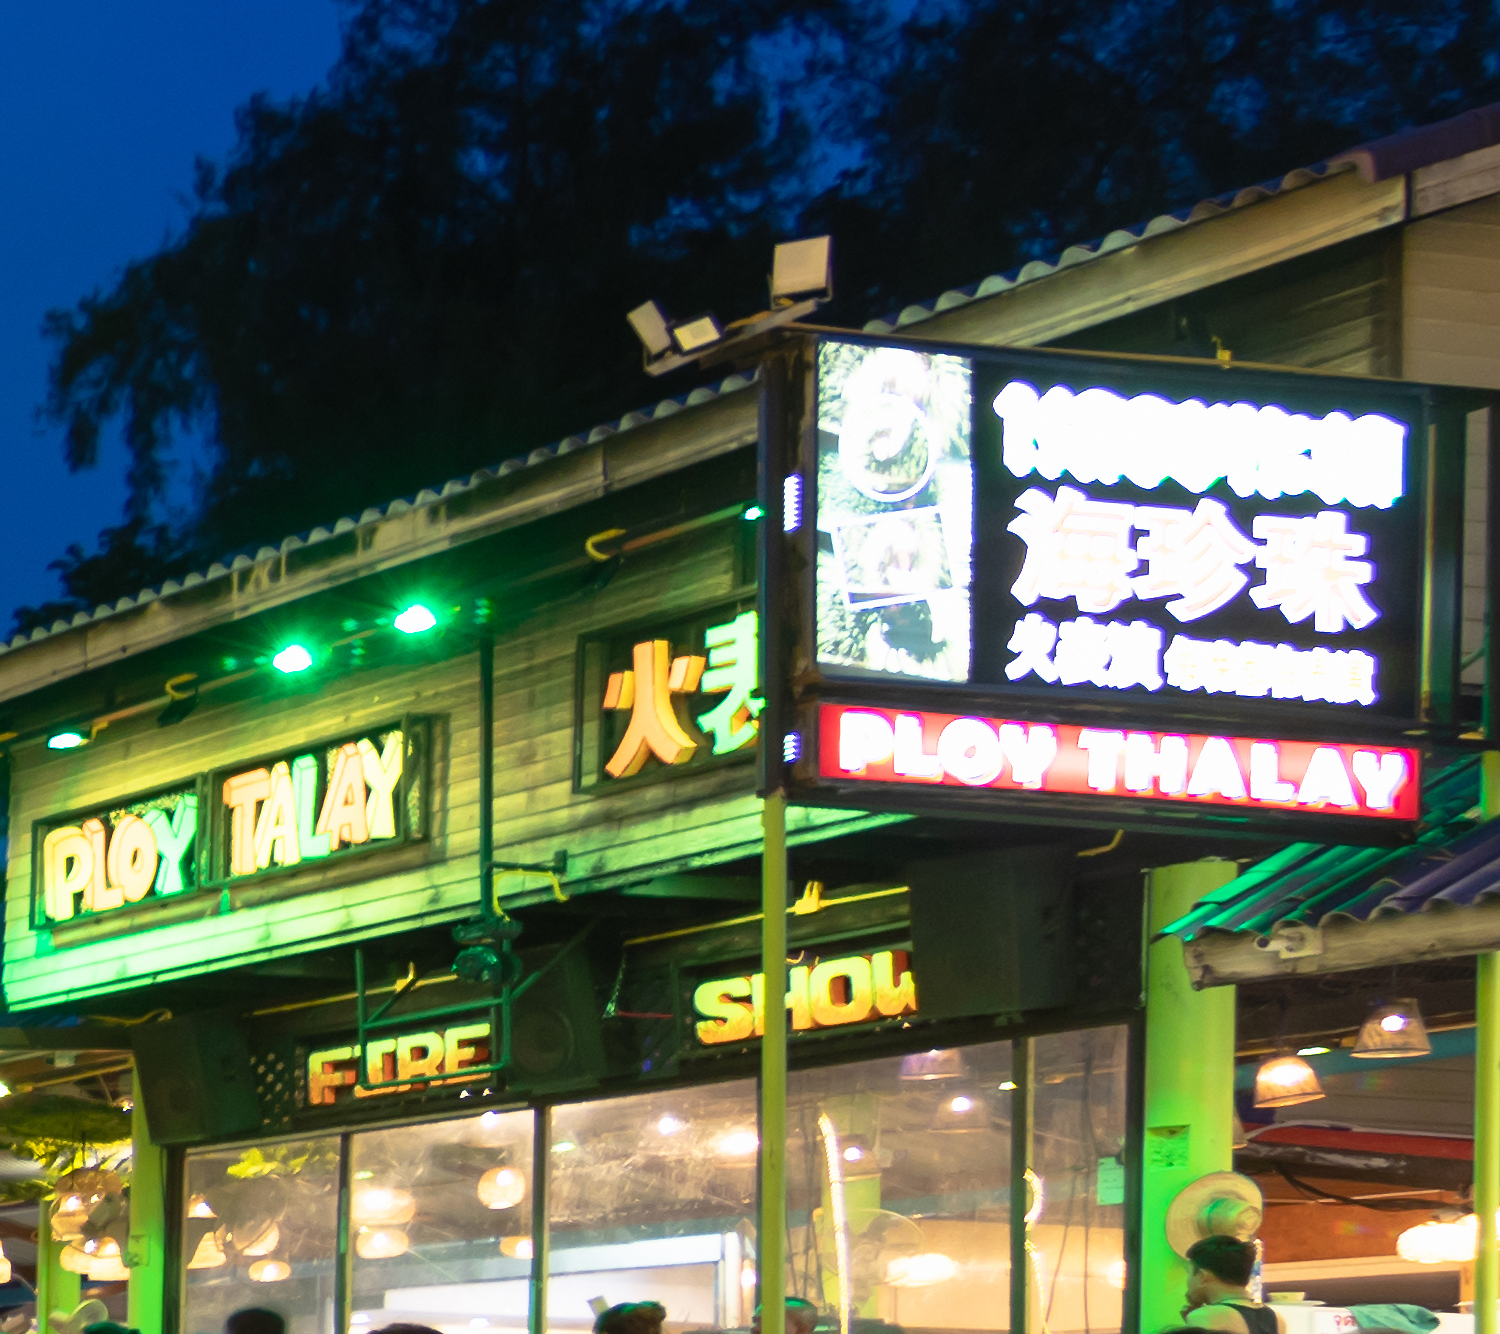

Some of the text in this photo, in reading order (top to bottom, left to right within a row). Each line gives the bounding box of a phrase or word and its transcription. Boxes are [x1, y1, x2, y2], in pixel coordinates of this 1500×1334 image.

[1007, 484, 1381, 634] 海珍珠
[837, 709, 1408, 813] PLOY THALAY
[44, 730, 403, 922] PLOY TALAY
[308, 1022, 491, 1106] FIRE
